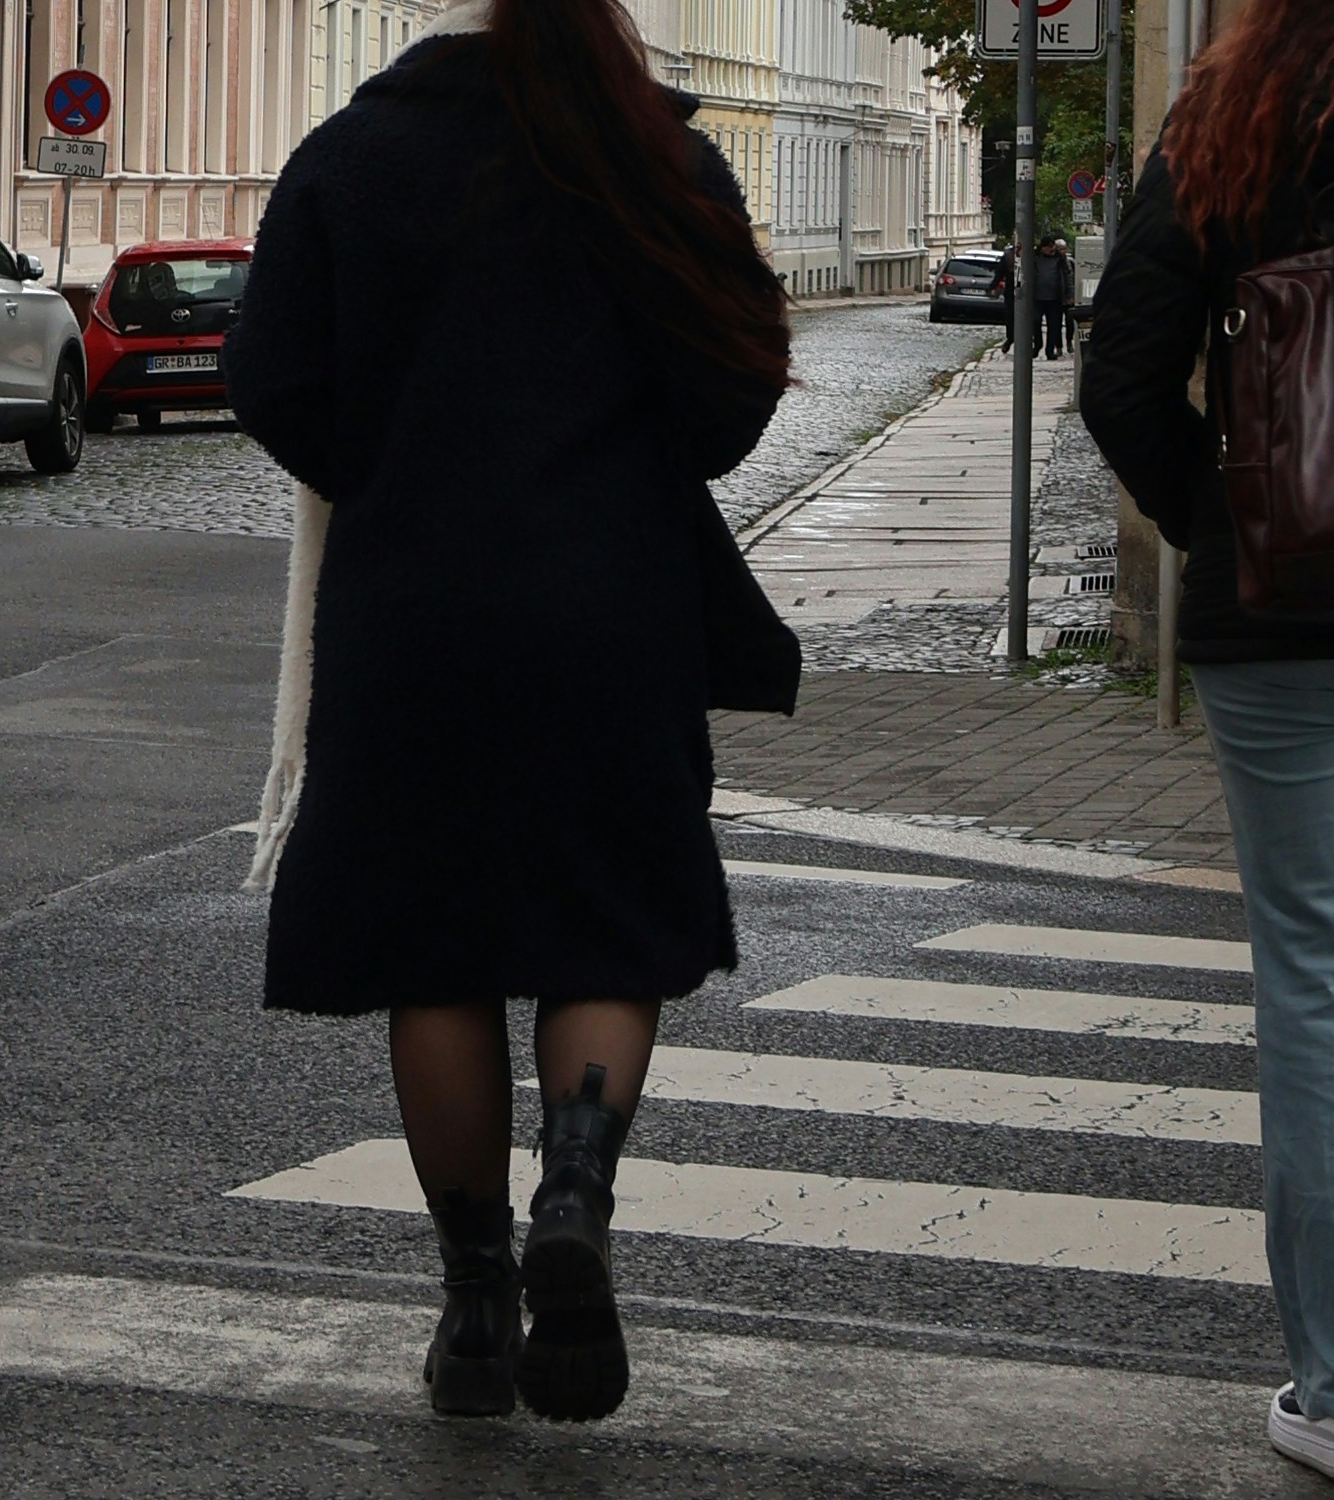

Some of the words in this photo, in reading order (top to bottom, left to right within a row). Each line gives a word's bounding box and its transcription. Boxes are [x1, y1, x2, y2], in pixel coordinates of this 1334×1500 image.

[50, 144, 60, 152] ab
[155, 356, 169, 369] GR
[176, 356, 192, 369] BA
[195, 355, 216, 368] 123
